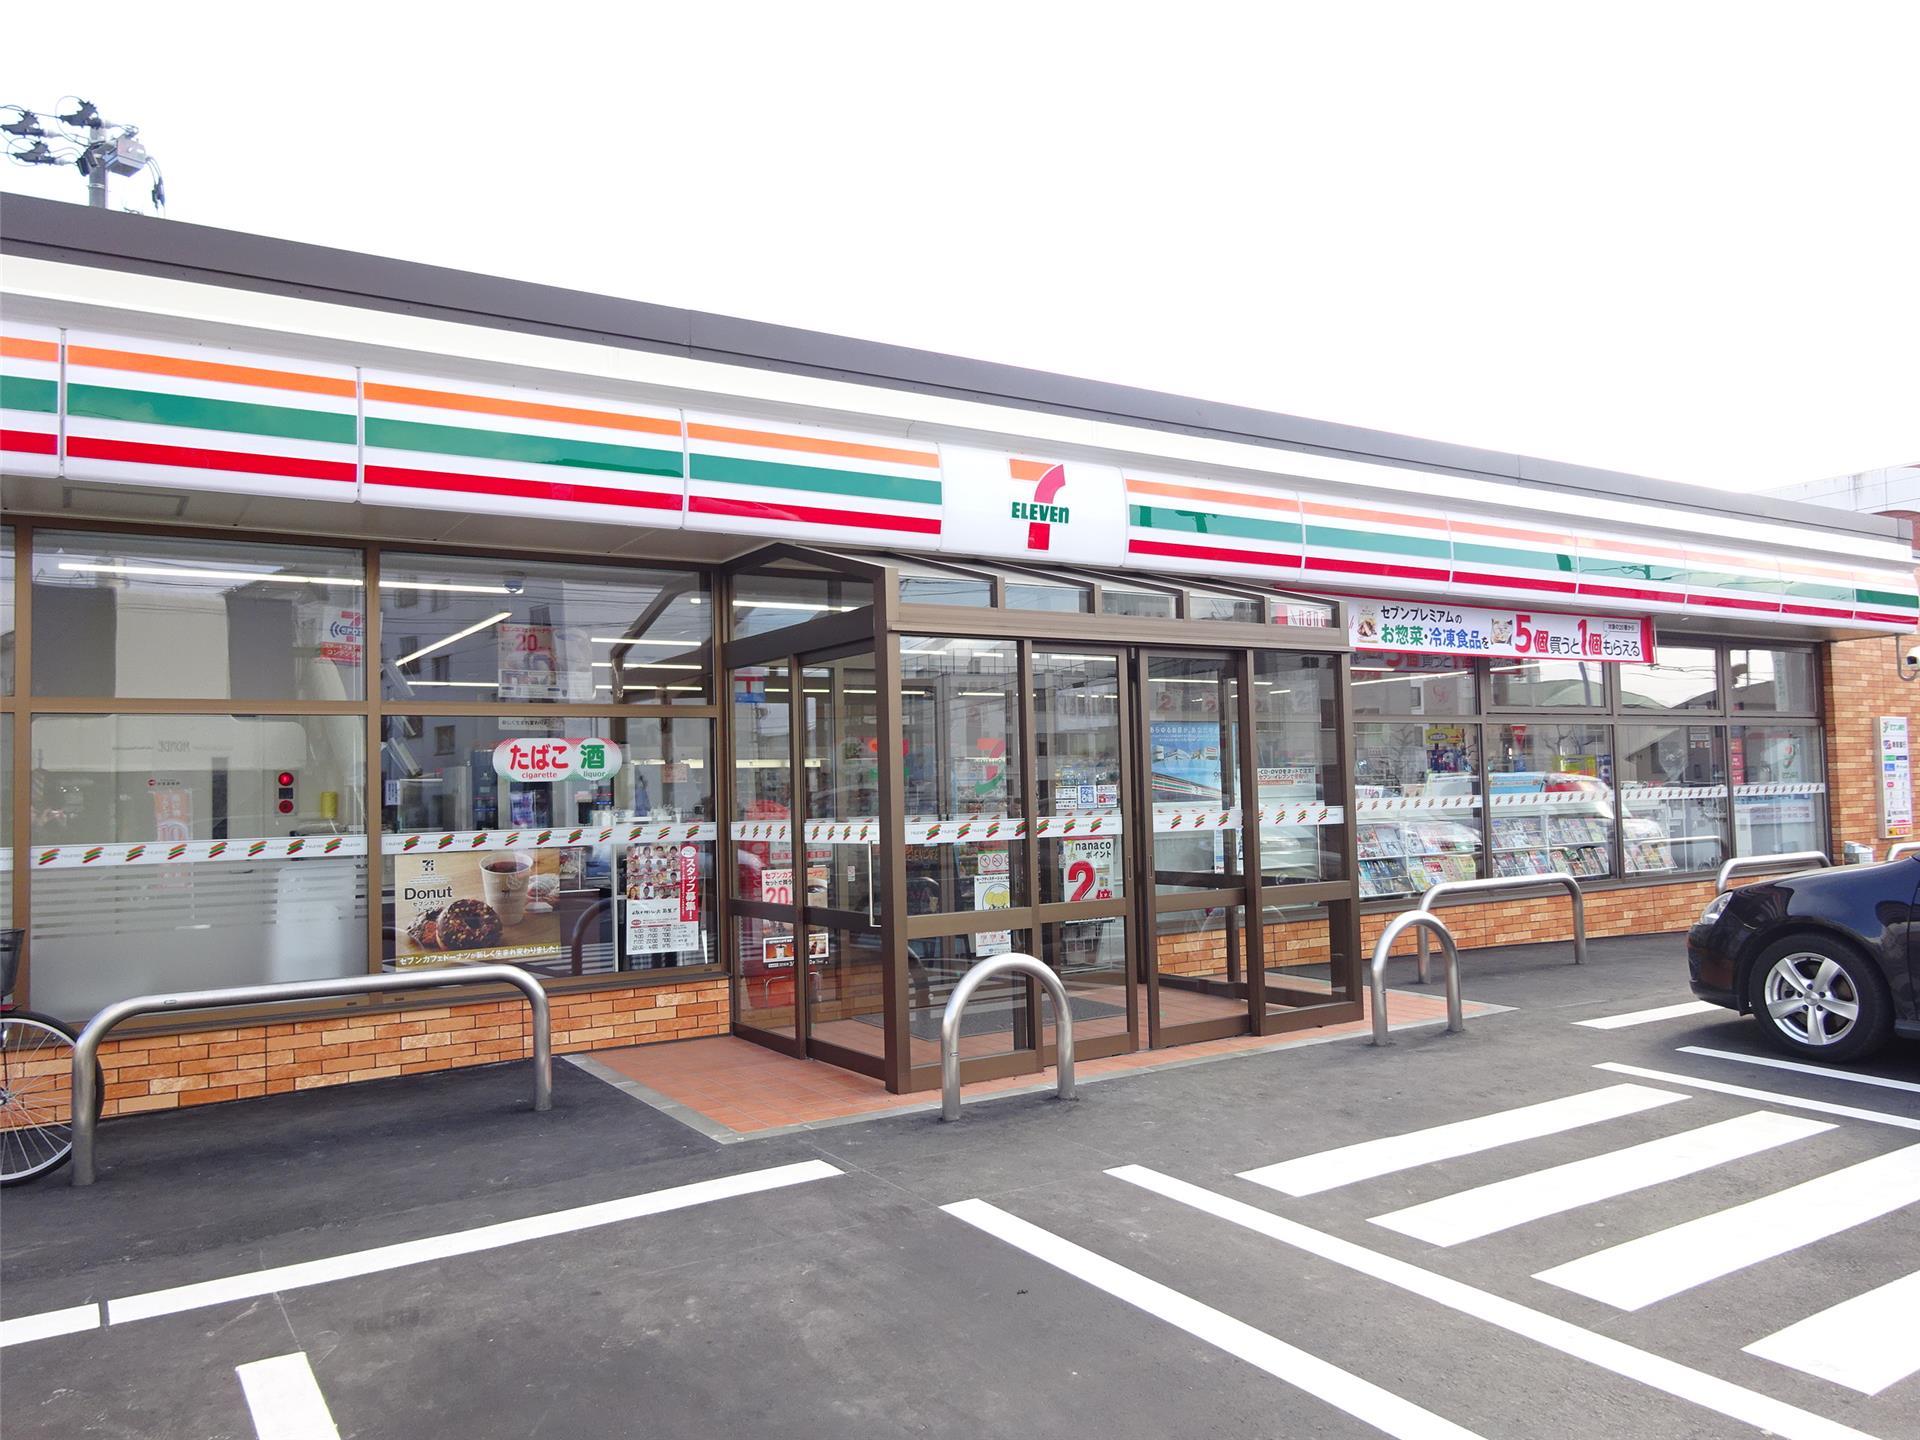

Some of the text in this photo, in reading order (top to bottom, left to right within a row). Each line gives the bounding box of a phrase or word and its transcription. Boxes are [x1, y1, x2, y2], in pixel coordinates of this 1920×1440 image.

[1381, 605, 1463, 624] セブンプレミアムの
[510, 743, 605, 771] たばこ 酒
[521, 769, 607, 780] cigarette liquor
[1074, 841, 1112, 851] nanaco
[1085, 850, 1112, 859] ポイント
[404, 886, 452, 900] Donut
